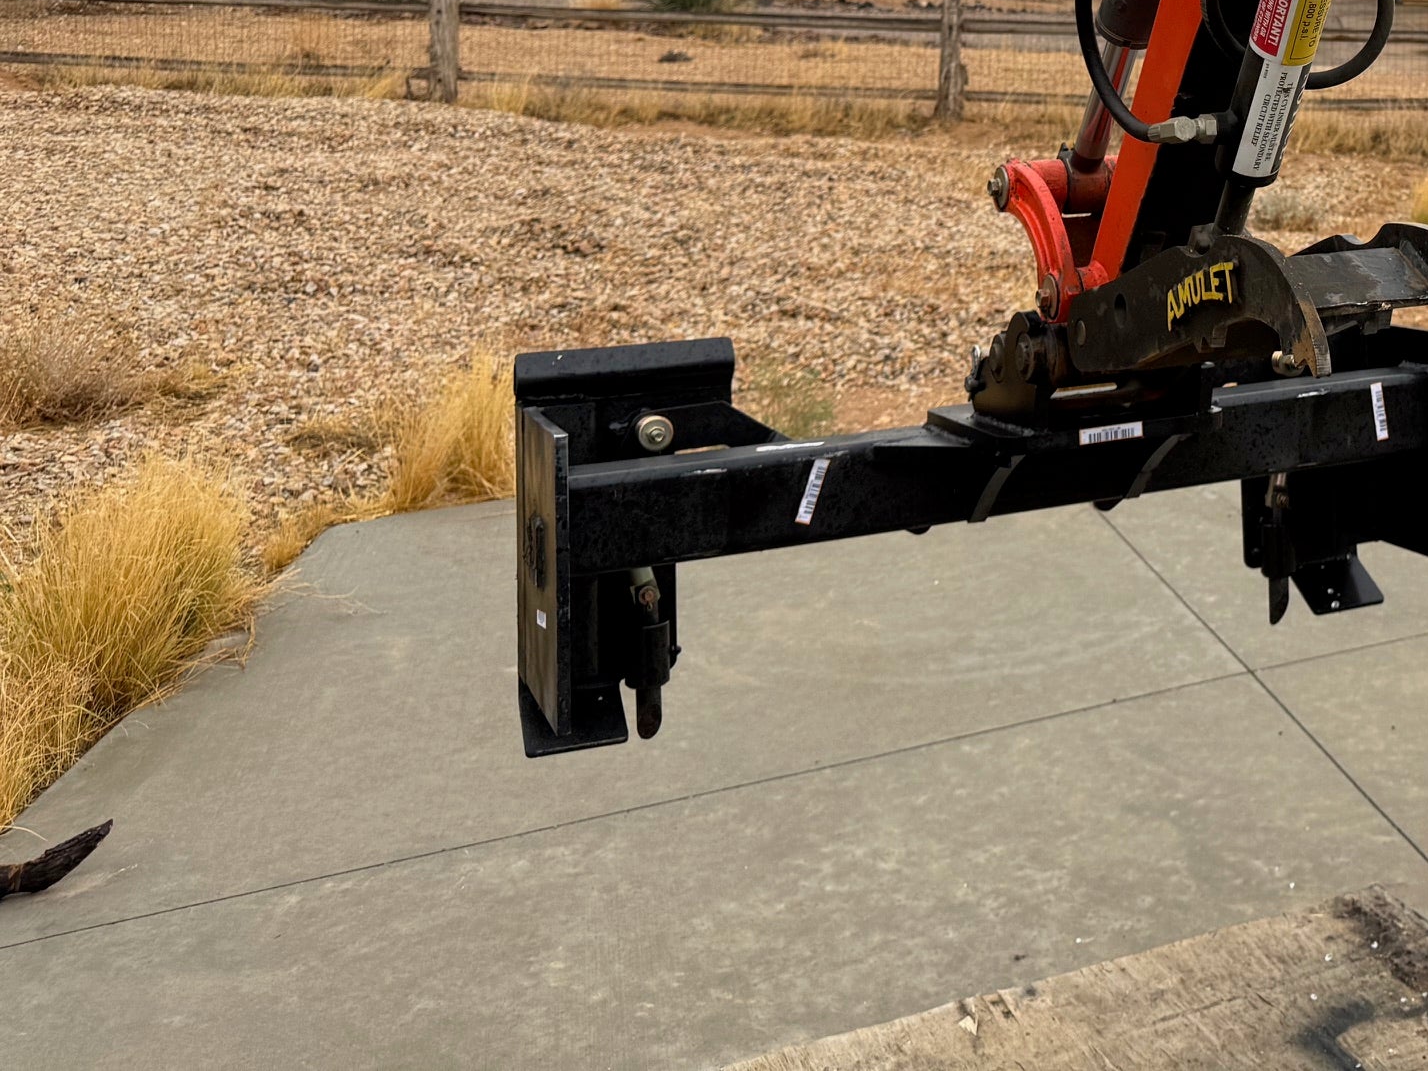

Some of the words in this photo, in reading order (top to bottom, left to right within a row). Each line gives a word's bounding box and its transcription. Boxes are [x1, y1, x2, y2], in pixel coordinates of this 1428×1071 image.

[1263, 11, 1271, 28] WITH
[1309, 36, 1317, 47] TO
[1270, 72, 1287, 112] PROTECTED
[1258, 94, 1272, 122] CIRCUIT
[1251, 122, 1263, 147] RELIEF
[1264, 113, 1276, 131] WITH
[1253, 131, 1269, 171] SECONDARY
[1167, 261, 1234, 332] AMULET
